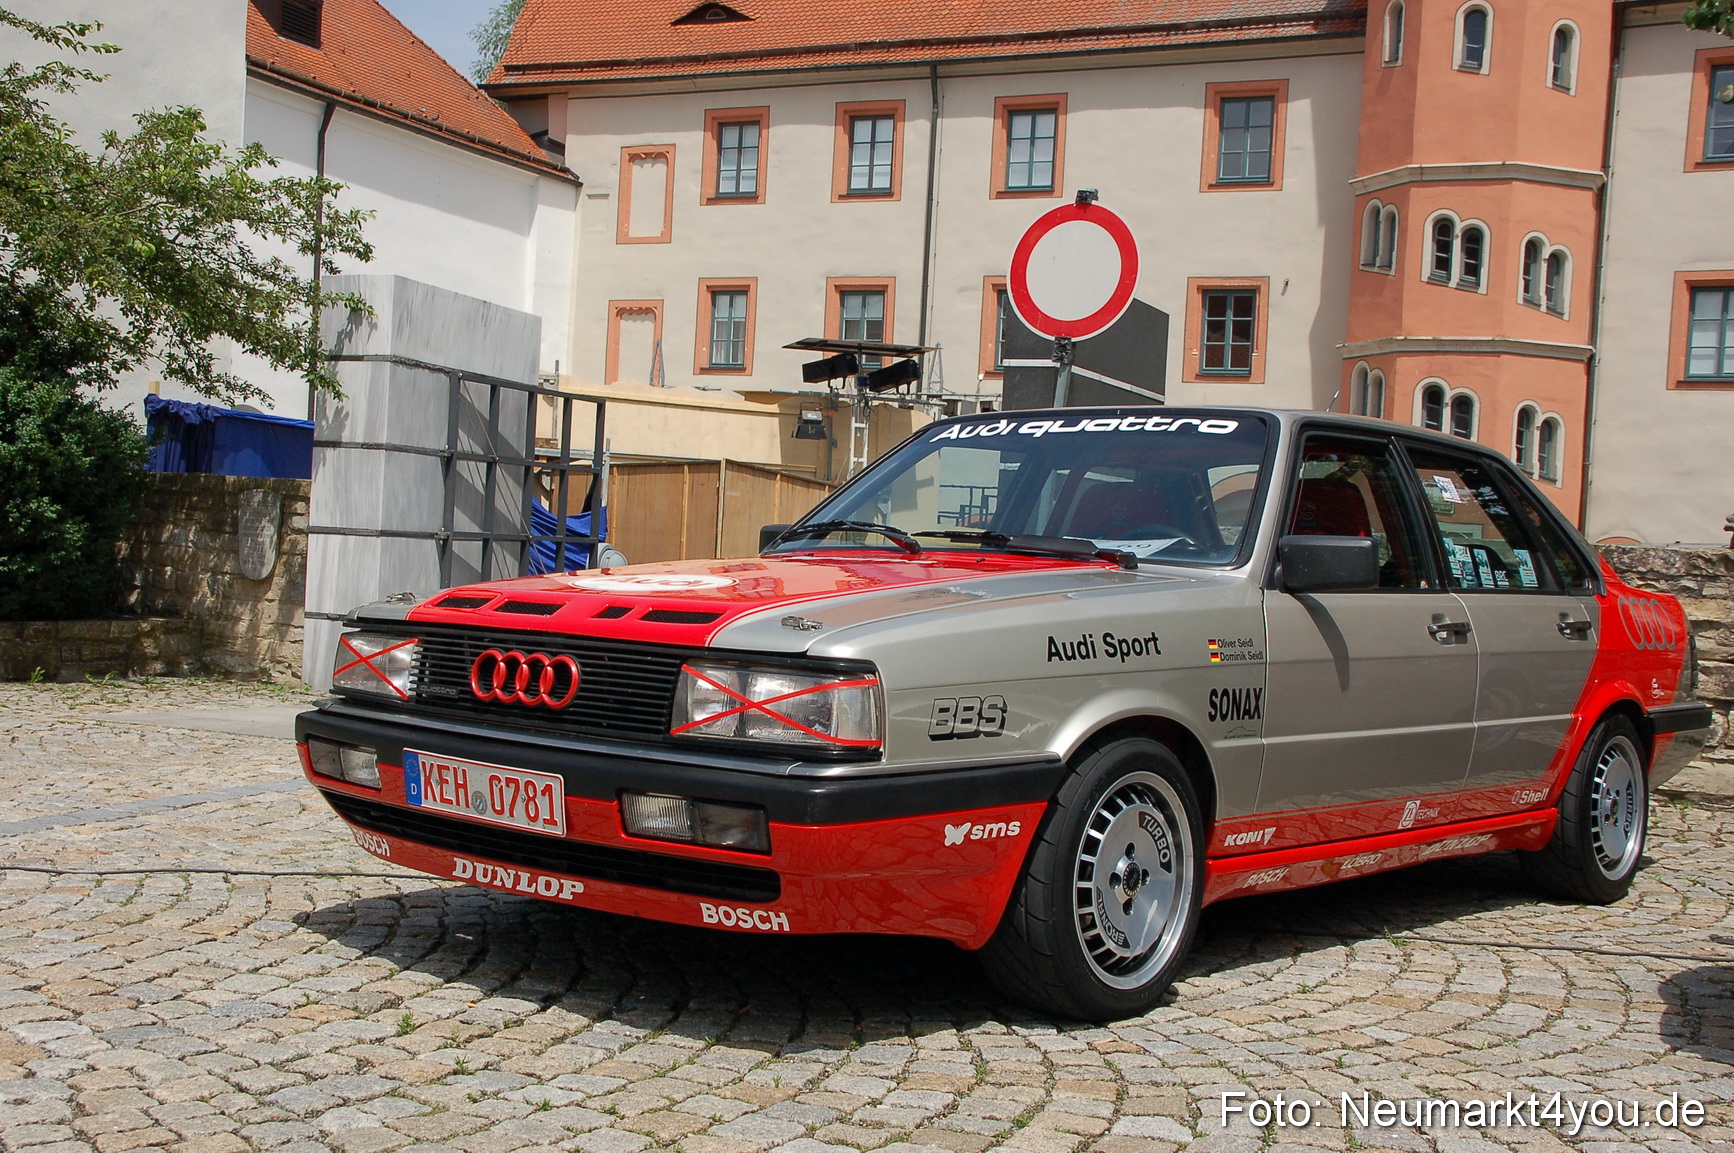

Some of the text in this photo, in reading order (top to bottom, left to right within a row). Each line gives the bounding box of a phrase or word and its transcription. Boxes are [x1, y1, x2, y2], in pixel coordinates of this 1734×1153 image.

[930, 415, 1239, 442] Audi quattro
[1047, 631, 1162, 663] Audi Sport
[1217, 638, 1254, 649] Oliver Seidl
[1220, 650, 1264, 662] Dominik Seidl
[928, 694, 1008, 740] BBS
[1208, 687, 1263, 722] SONAX
[410, 783, 418, 795] D
[421, 760, 558, 826] KEH 0781
[1519, 788, 1550, 804] Shell
[970, 821, 1021, 840] sms
[1143, 814, 1171, 864] TURBO
[1224, 831, 1264, 847] KONI
[452, 857, 585, 900] DUNLOP
[1242, 868, 1290, 889] BOSCH
[701, 902, 790, 932] BOSCH
